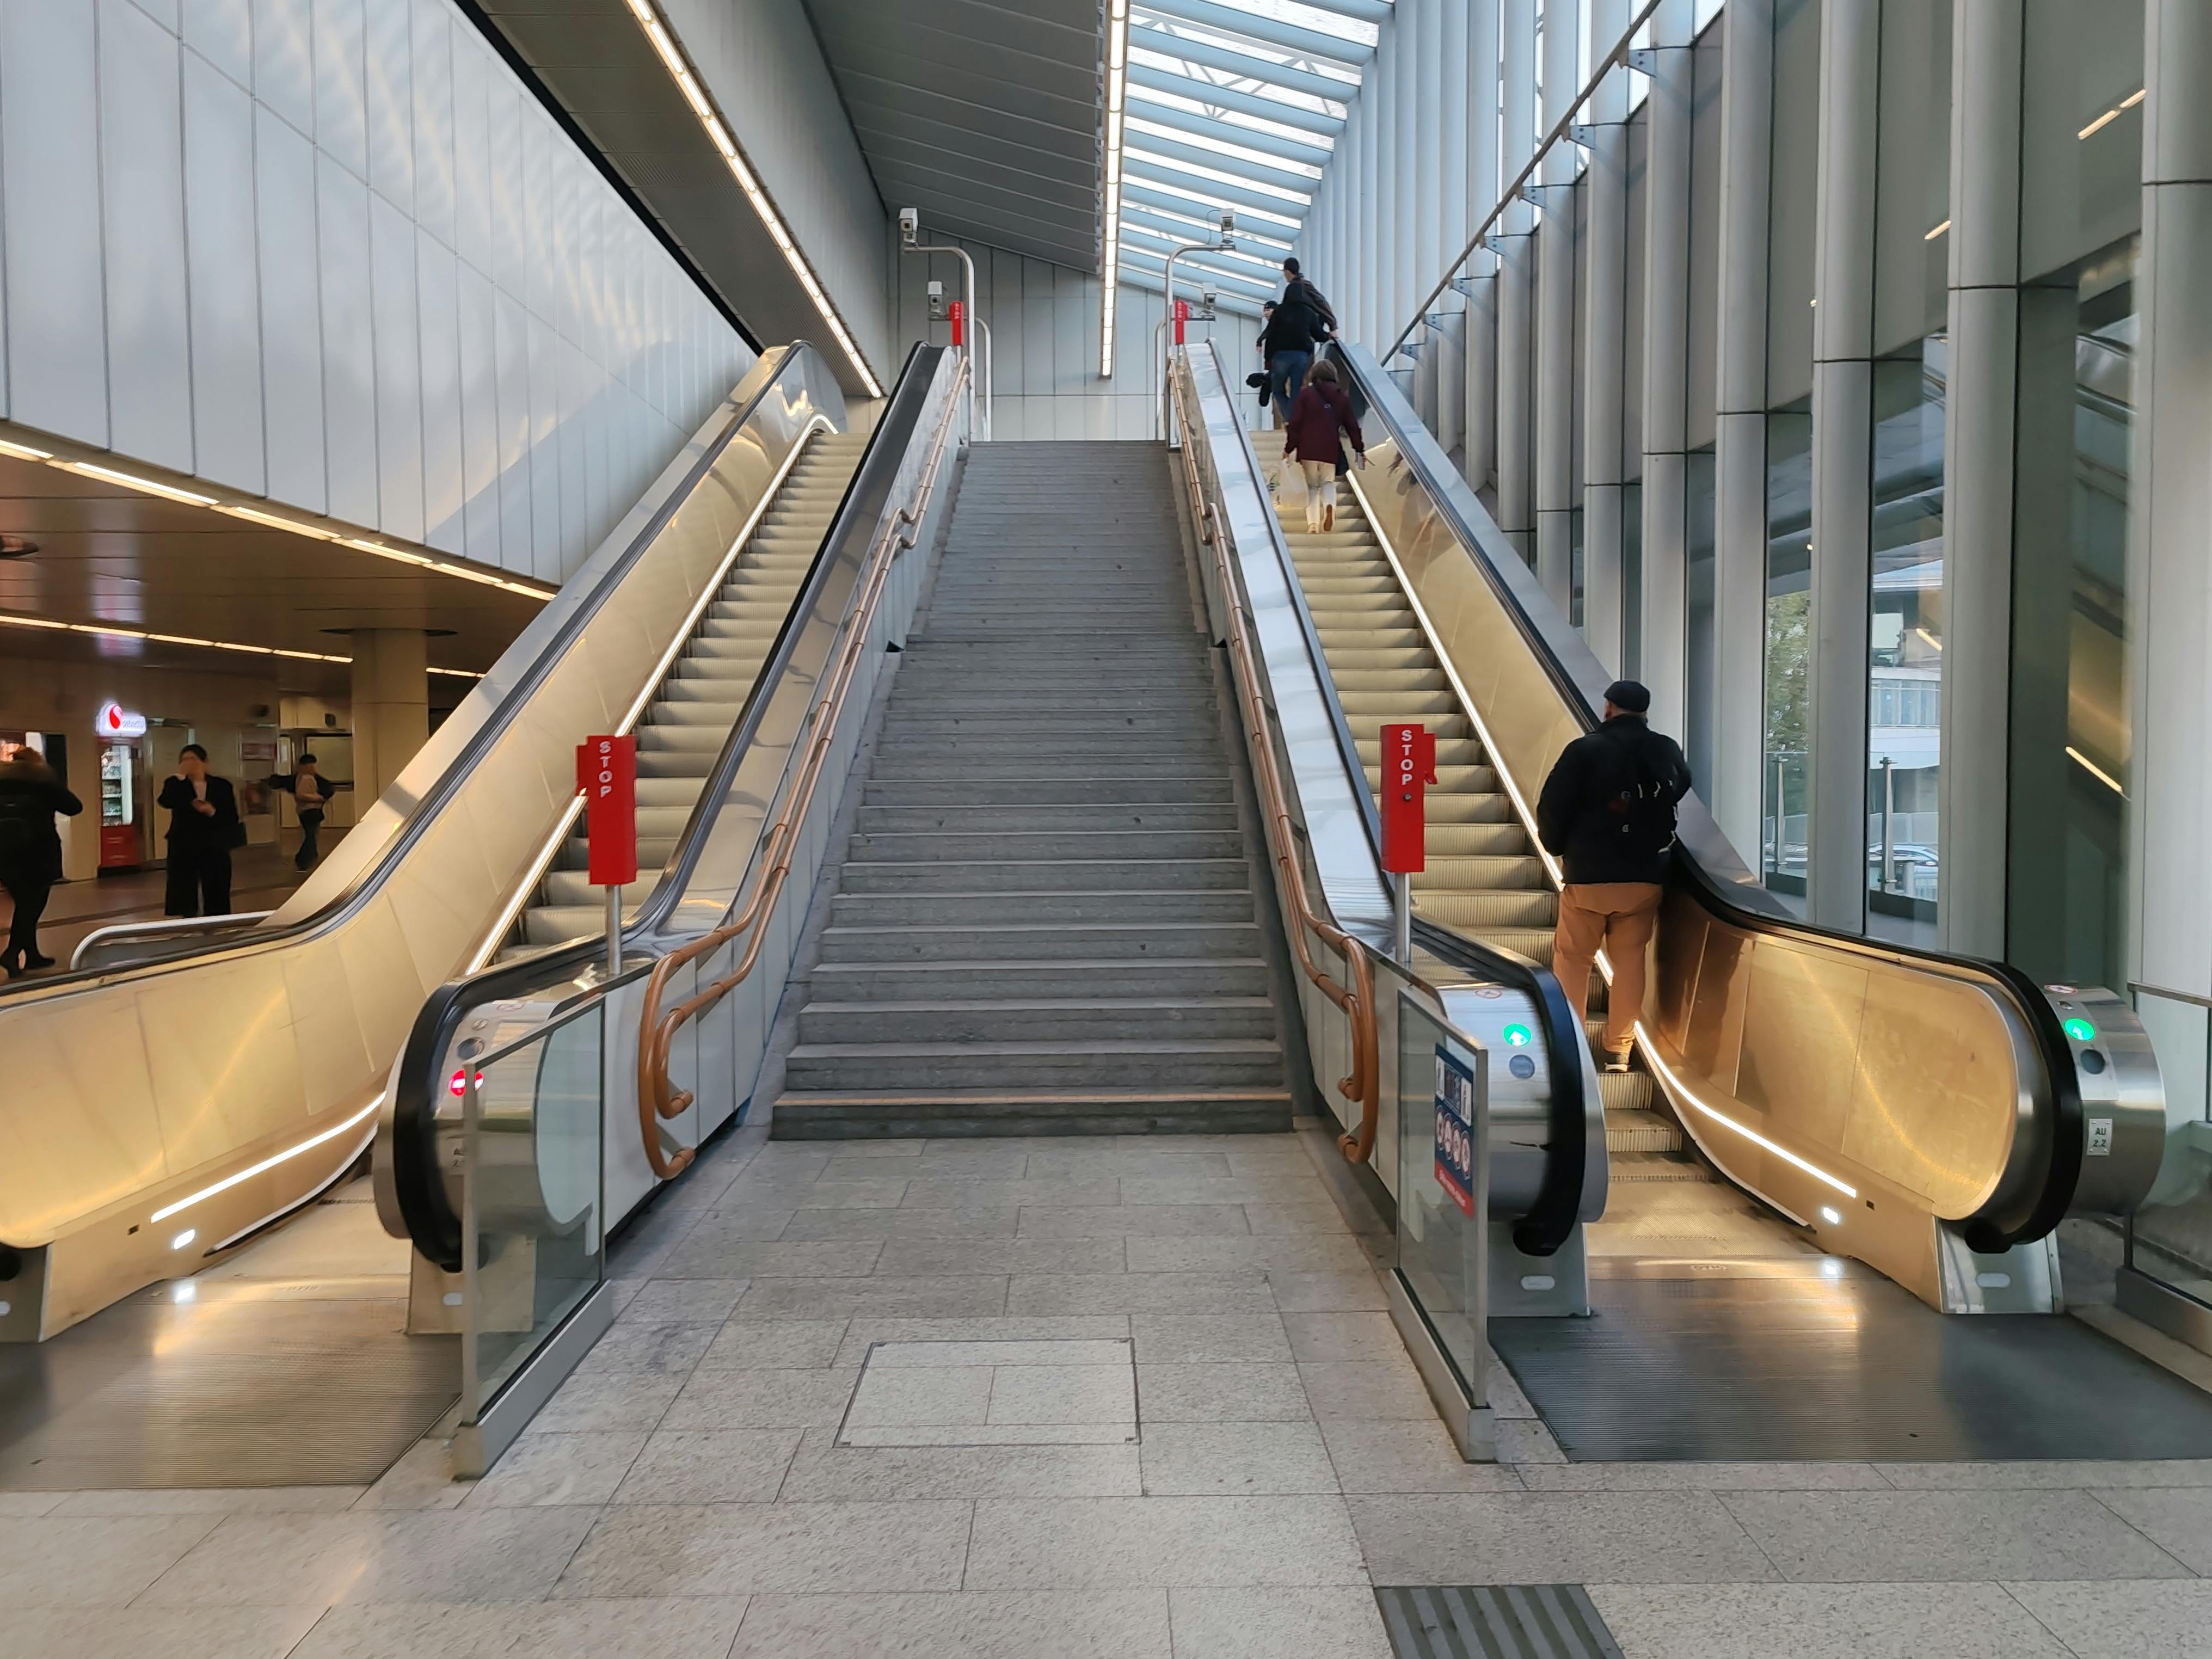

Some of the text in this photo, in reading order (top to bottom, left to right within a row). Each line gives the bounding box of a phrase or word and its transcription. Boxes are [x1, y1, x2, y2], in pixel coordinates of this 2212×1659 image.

[599, 741, 613, 798] STOP
[1400, 729, 1414, 785] STOP
[2095, 1127, 2107, 1135] AU
